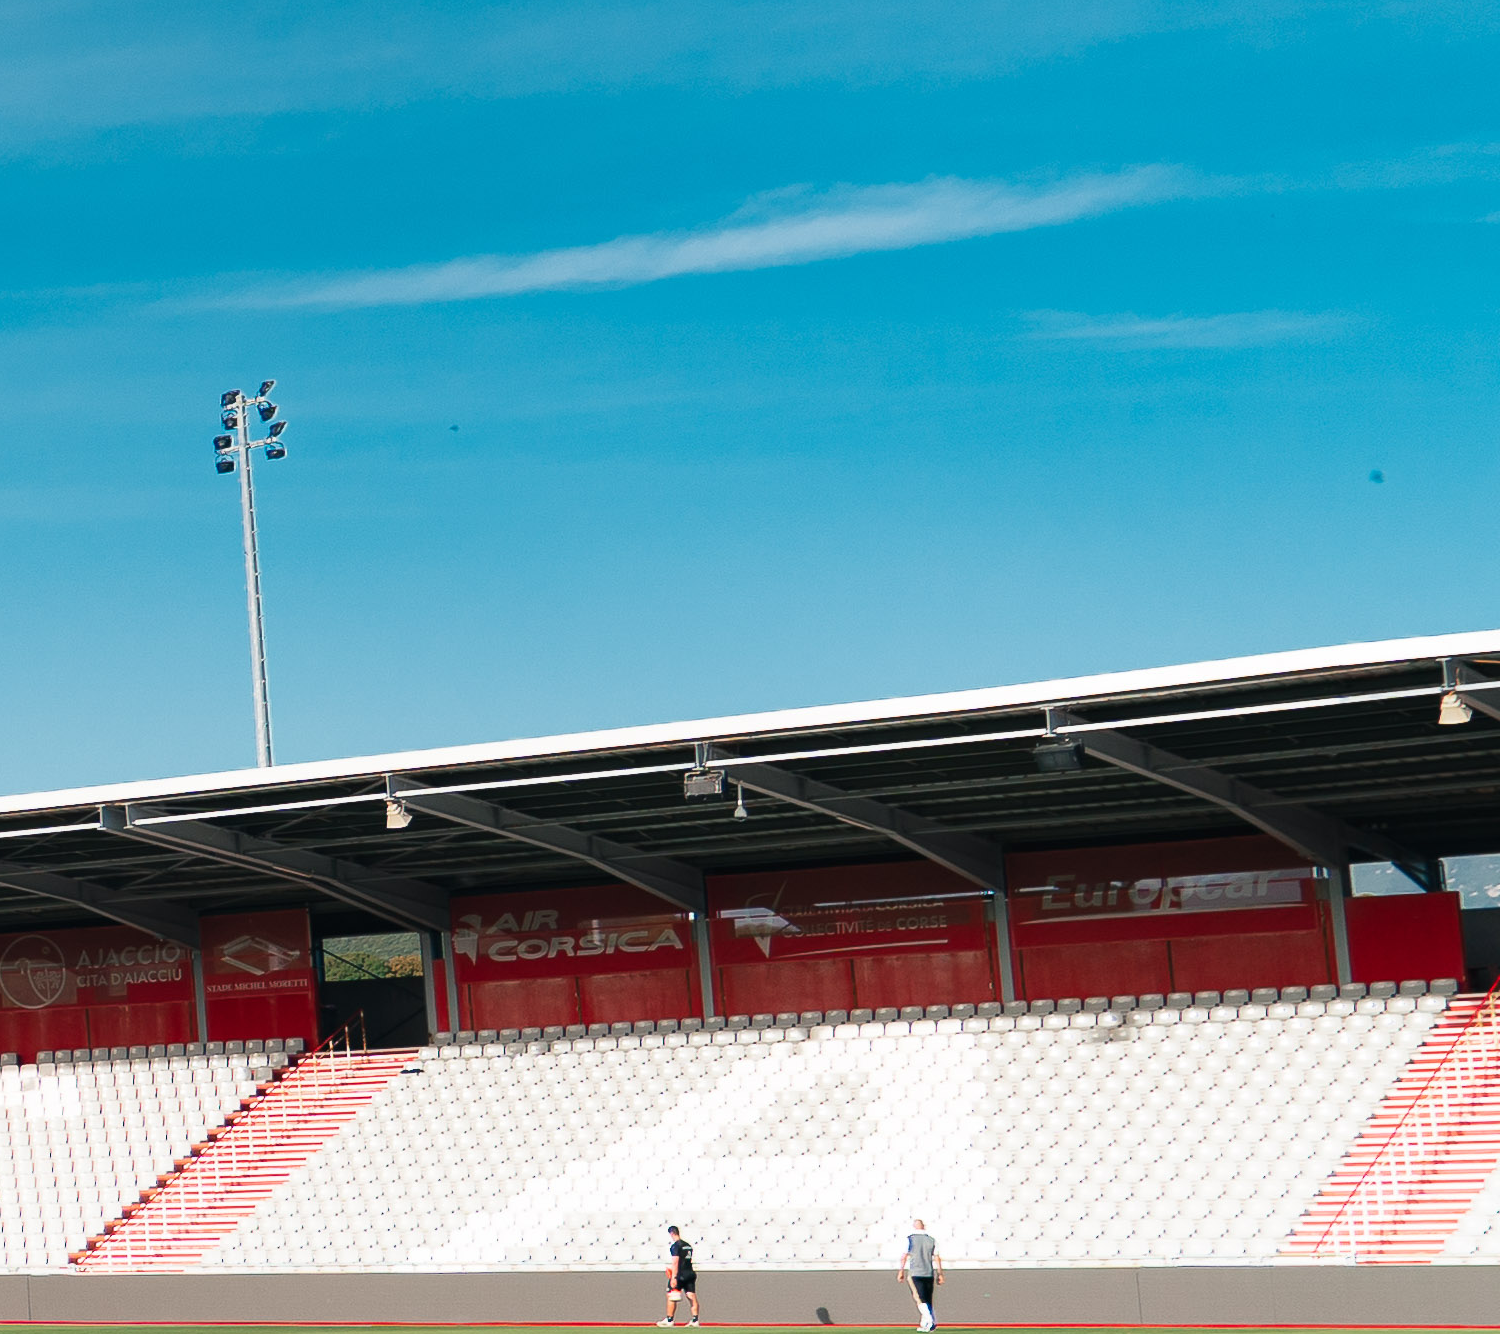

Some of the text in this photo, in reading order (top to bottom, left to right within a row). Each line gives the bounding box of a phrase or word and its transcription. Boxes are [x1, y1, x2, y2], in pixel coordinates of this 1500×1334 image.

[1041, 871, 1274, 910] Europcar
[486, 909, 559, 934] AIR
[896, 916, 948, 930] CORSE
[76, 945, 180, 969] AJACCIO
[488, 929, 683, 962] CORSICA
